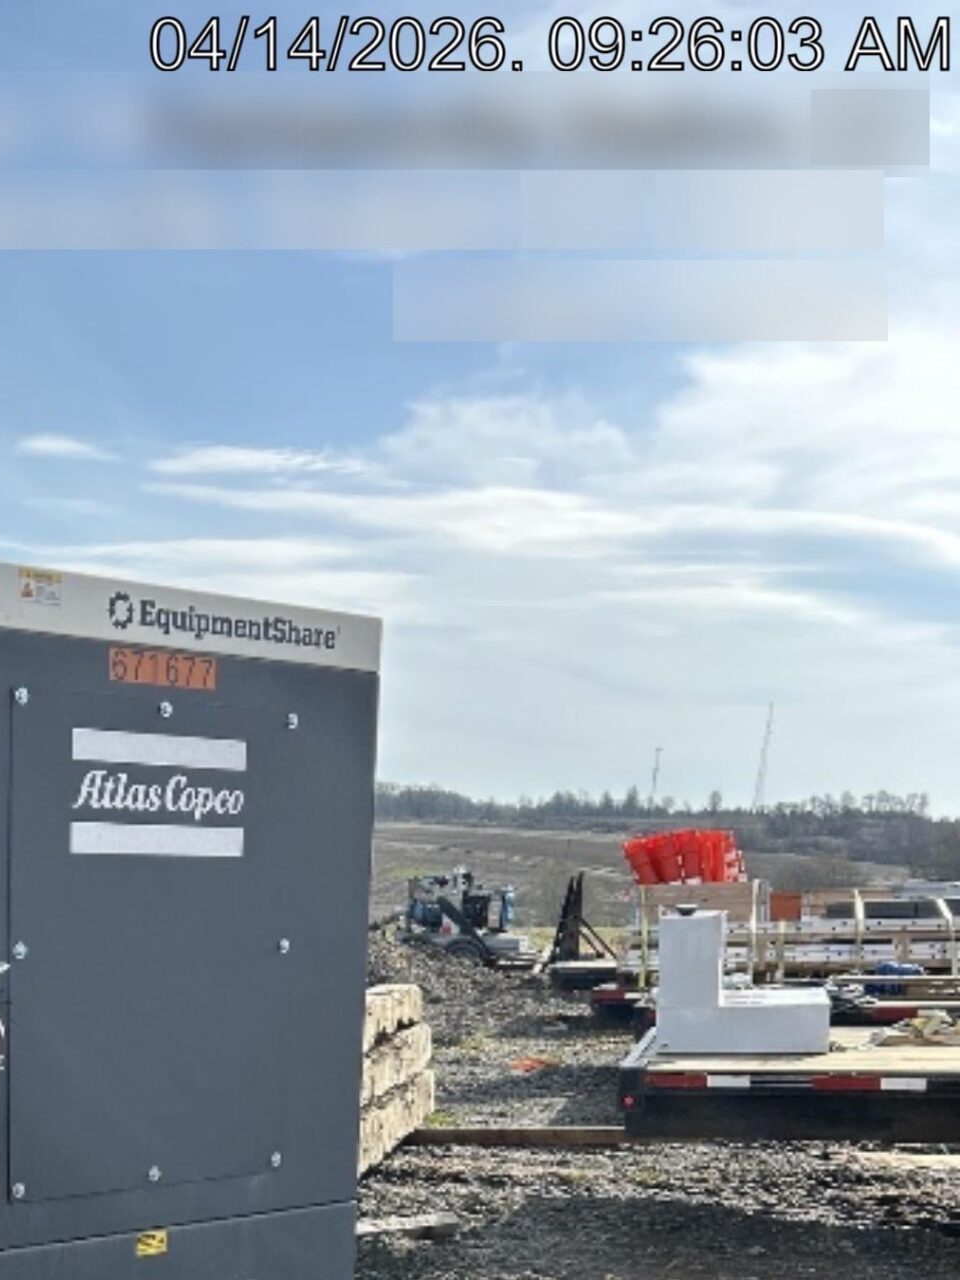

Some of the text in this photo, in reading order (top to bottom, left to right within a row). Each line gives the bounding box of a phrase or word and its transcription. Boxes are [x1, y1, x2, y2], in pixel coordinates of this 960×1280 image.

[140, 599, 337, 650] EquipmentShare
[111, 651, 215, 688] 671677
[72, 770, 245, 820] Atlas Copco
